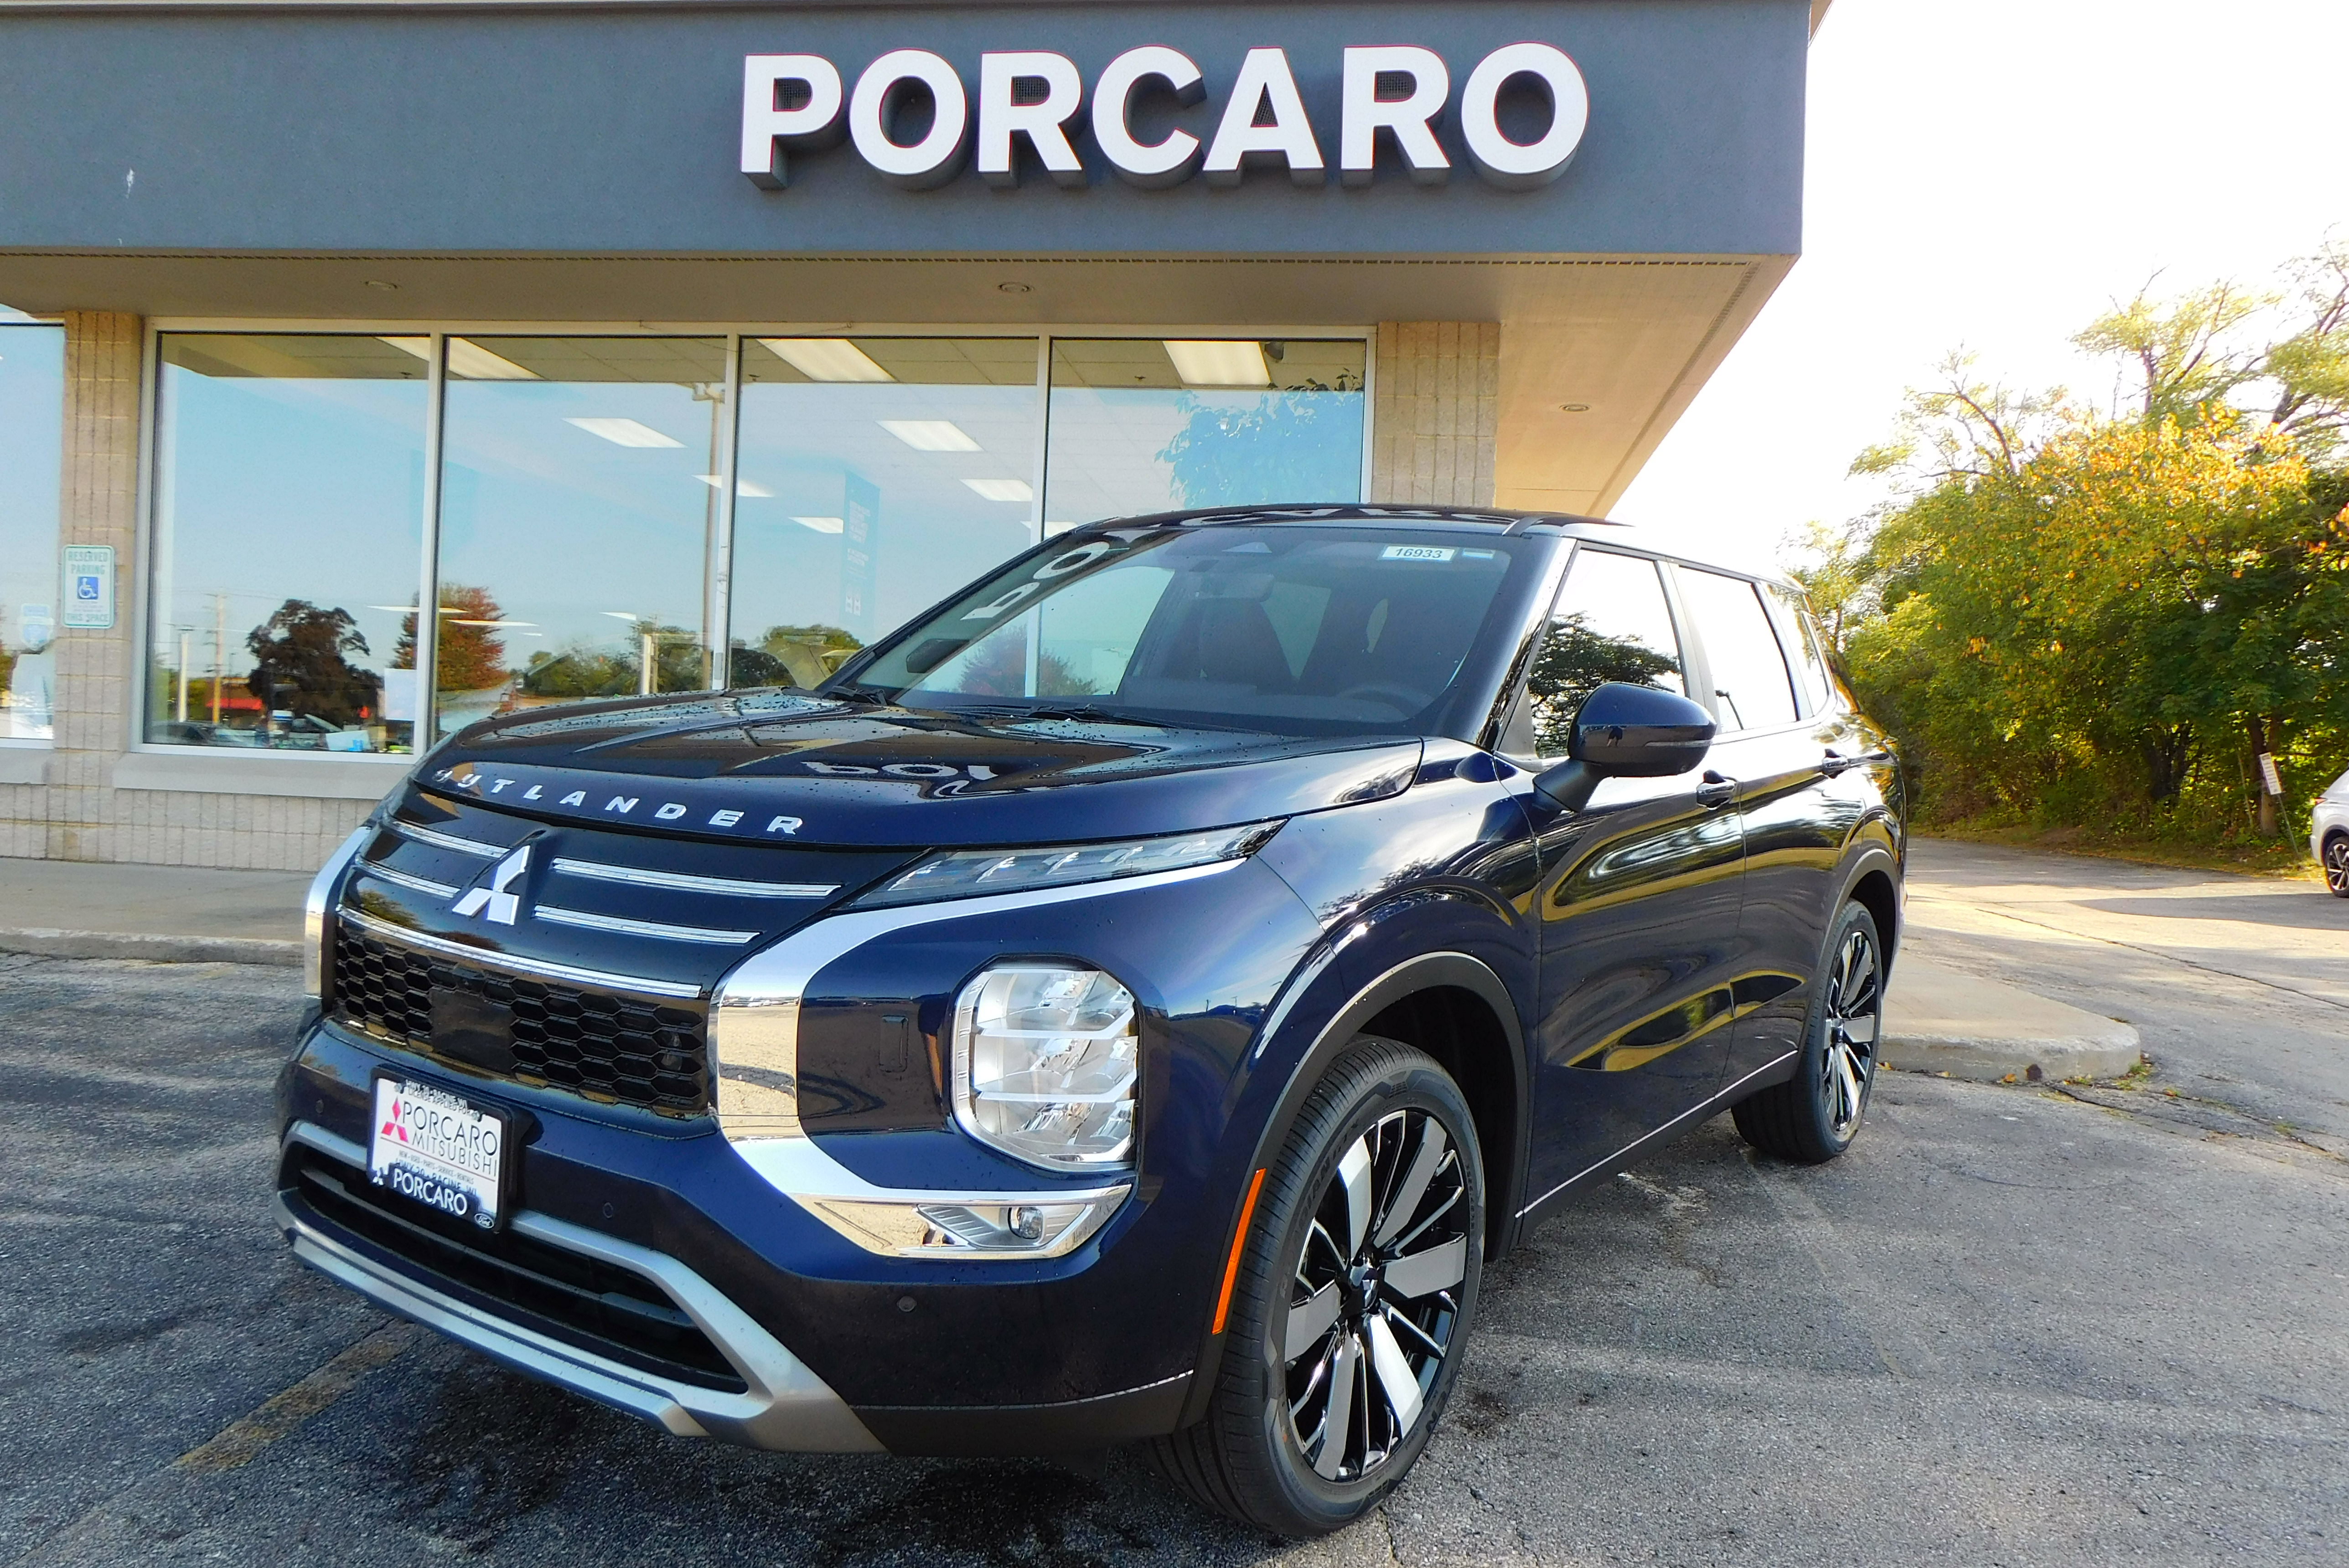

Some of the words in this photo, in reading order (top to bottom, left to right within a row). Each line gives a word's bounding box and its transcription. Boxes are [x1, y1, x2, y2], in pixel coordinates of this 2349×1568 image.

[740, 42, 1590, 176] PORCARO
[68, 552, 108, 562] RESERVED
[71, 564, 106, 574] PARKING
[1396, 548, 1443, 559] 16933
[87, 614, 109, 622] SPACE
[432, 769, 803, 836] OUTLANDER
[403, 1101, 497, 1156] PORCARO
[412, 1131, 497, 1177] MITSUBISHI
[393, 1168, 467, 1216] PORCARO
